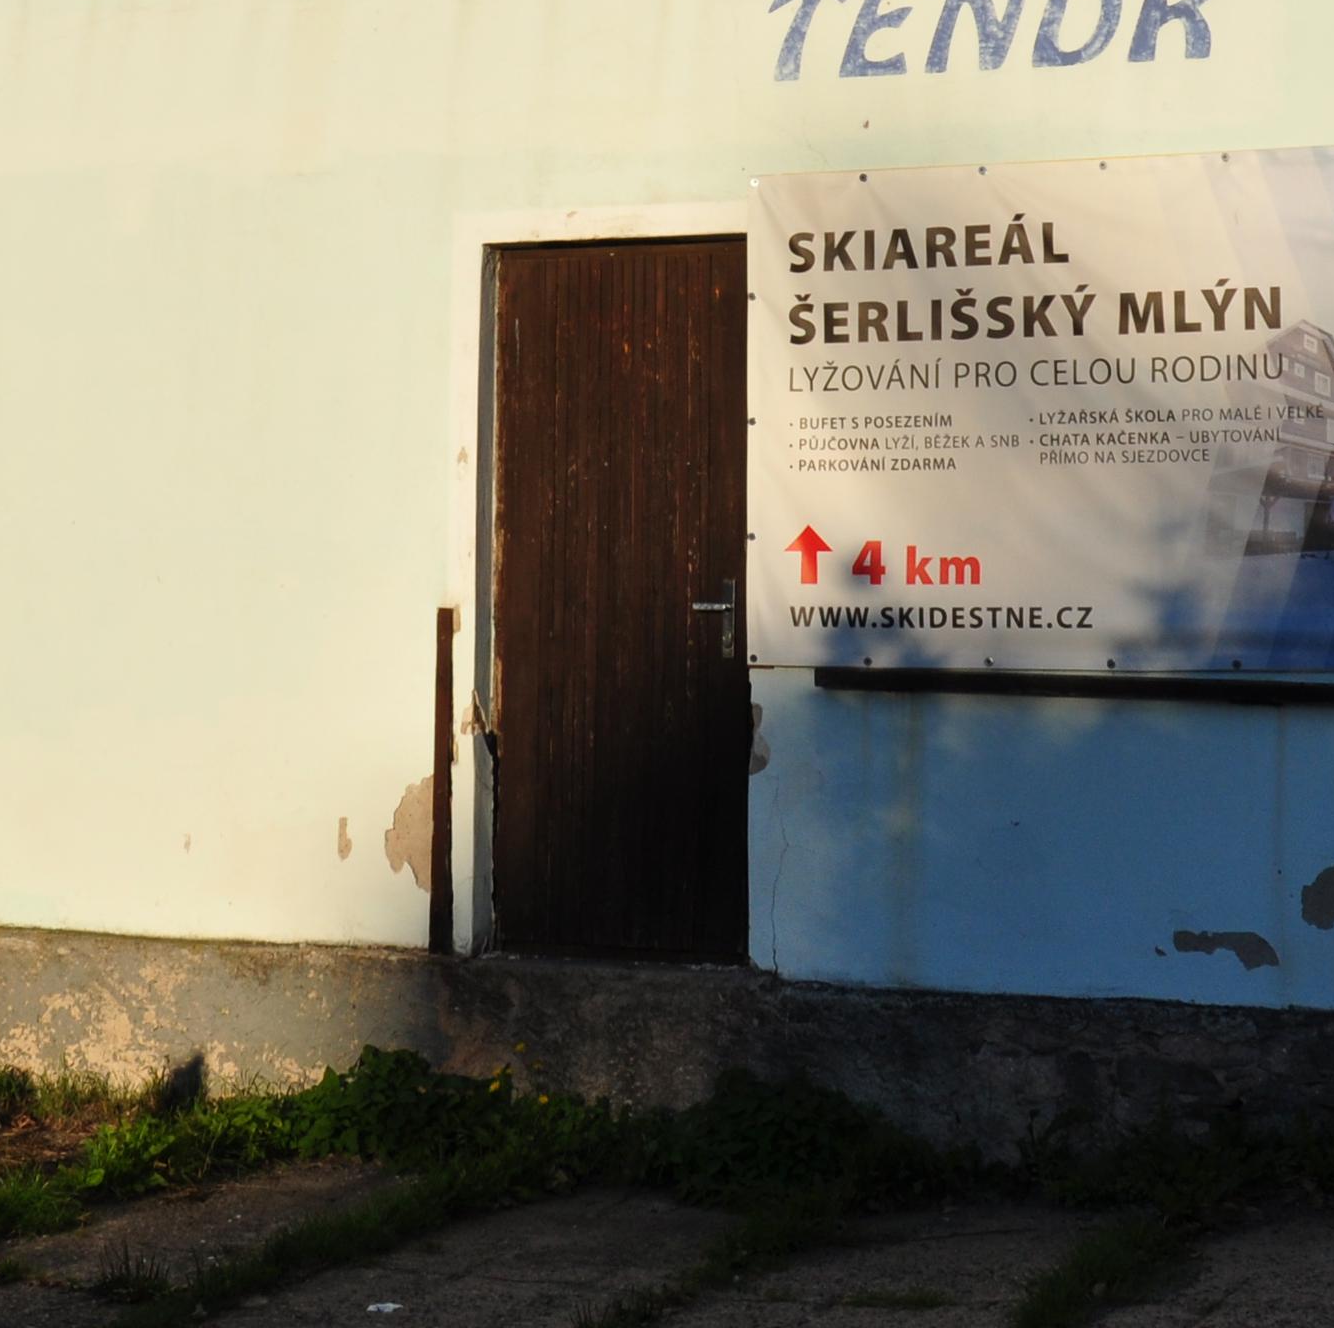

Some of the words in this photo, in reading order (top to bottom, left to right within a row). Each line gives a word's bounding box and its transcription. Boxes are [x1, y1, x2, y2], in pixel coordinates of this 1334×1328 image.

[788, 213, 1070, 273] SKIAREÁL
[788, 284, 1096, 345] ŠERLIŠSKÝ
[1118, 278, 1283, 335] MLÝN
[789, 358, 942, 393] LYŽOVÁNÍ
[955, 361, 1017, 388] PRO
[1030, 357, 1136, 387] CELOU
[1151, 353, 1284, 383] RODINU
[799, 417, 846, 430] BUFET
[852, 417, 860, 430] S
[864, 412, 953, 429] POSEZENÍM
[1039, 408, 1118, 425] LYŽAŘSKÁ
[1125, 407, 1176, 423] ŠKOLA
[1182, 408, 1213, 421] PRO
[1219, 405, 1262, 420] MALÉ
[1267, 407, 1271, 419] I
[1276, 404, 1324, 419] VELKÉ
[798, 435, 880, 451] PŮJČOVNA
[924, 433, 970, 449] BĚŽEK
[975, 435, 985, 448] A
[990, 434, 1020, 448] SNB
[1039, 432, 1090, 446] CHATA
[1096, 430, 1170, 445] KAČENKA
[1190, 428, 1280, 444] UBYTOVÁNÍ
[798, 457, 886, 472] PARKOVÁNÍ
[890, 457, 957, 470] ZDARMA
[1040, 449, 1089, 465] PŘÍMO
[1095, 450, 1116, 464] NA
[1121, 448, 1210, 464] SJEZDOVCE
[852, 540, 886, 585] 4
[906, 545, 981, 585] km
[790, 606, 1093, 629] WWW.SKIDESTNE.CZ
